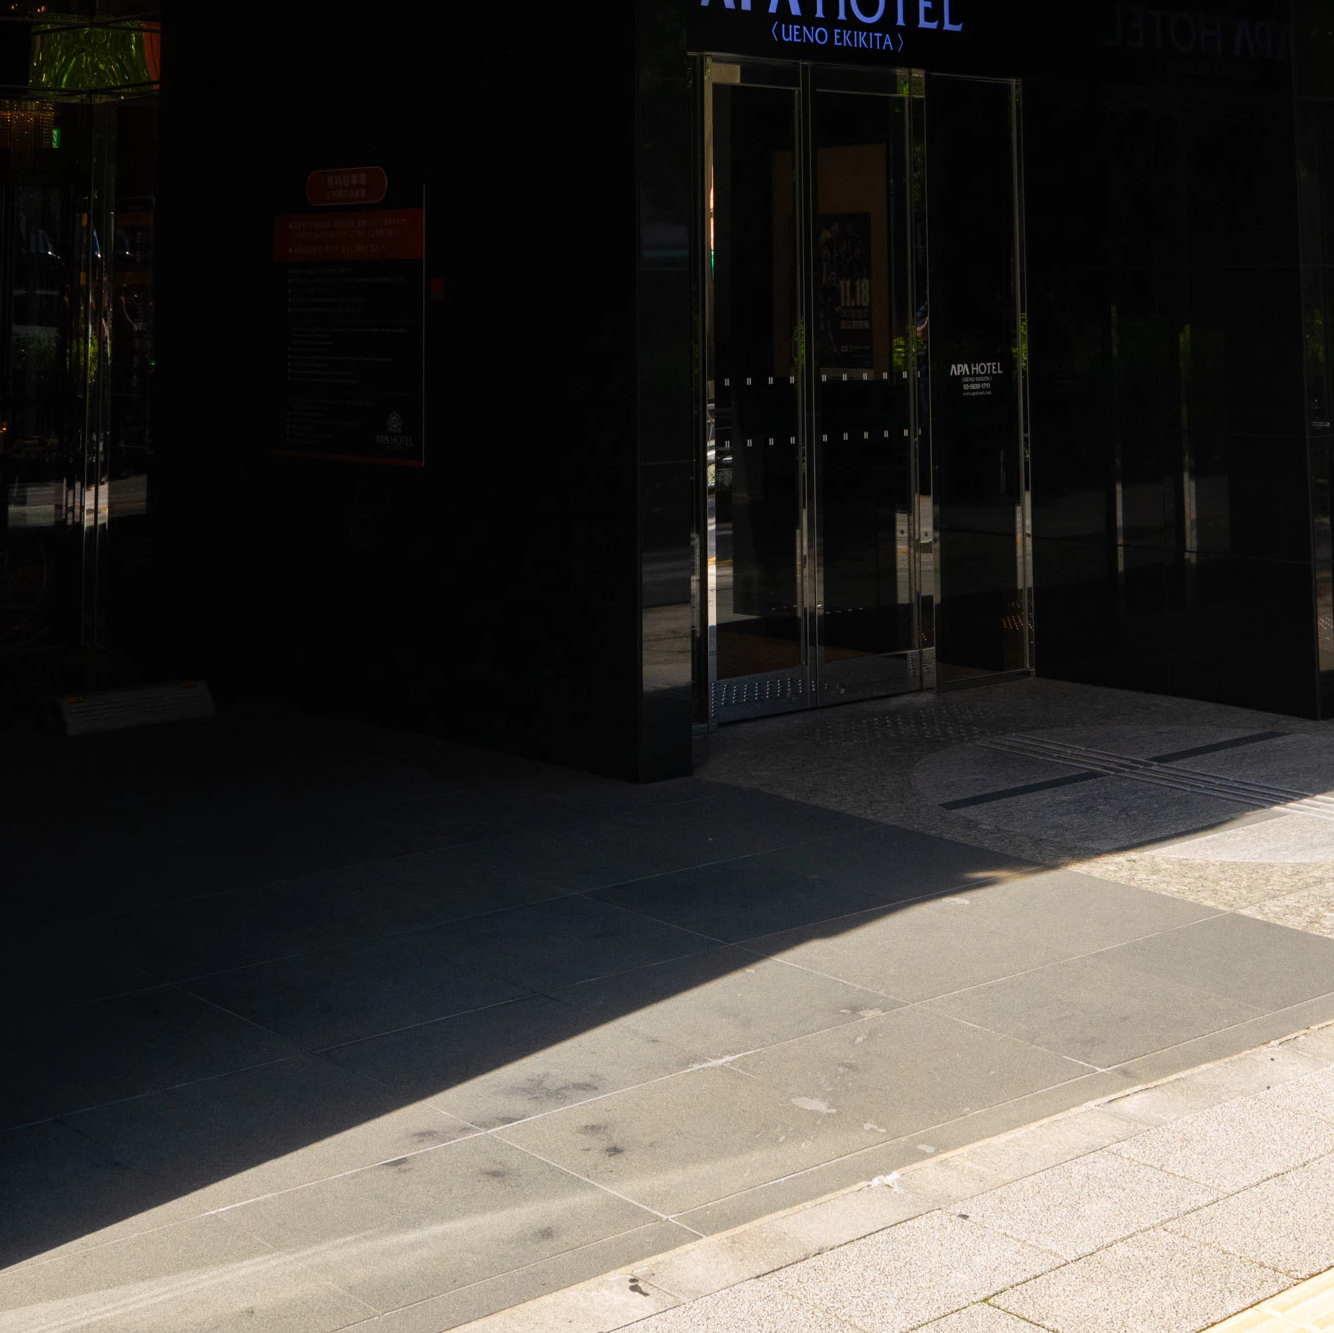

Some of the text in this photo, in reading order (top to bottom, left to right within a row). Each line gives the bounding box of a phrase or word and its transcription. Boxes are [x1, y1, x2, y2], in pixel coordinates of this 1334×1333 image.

[840, 278, 870, 306] 11.18
[950, 362, 1003, 376] APA HOTEL
[390, 435, 415, 446] HOTEL
